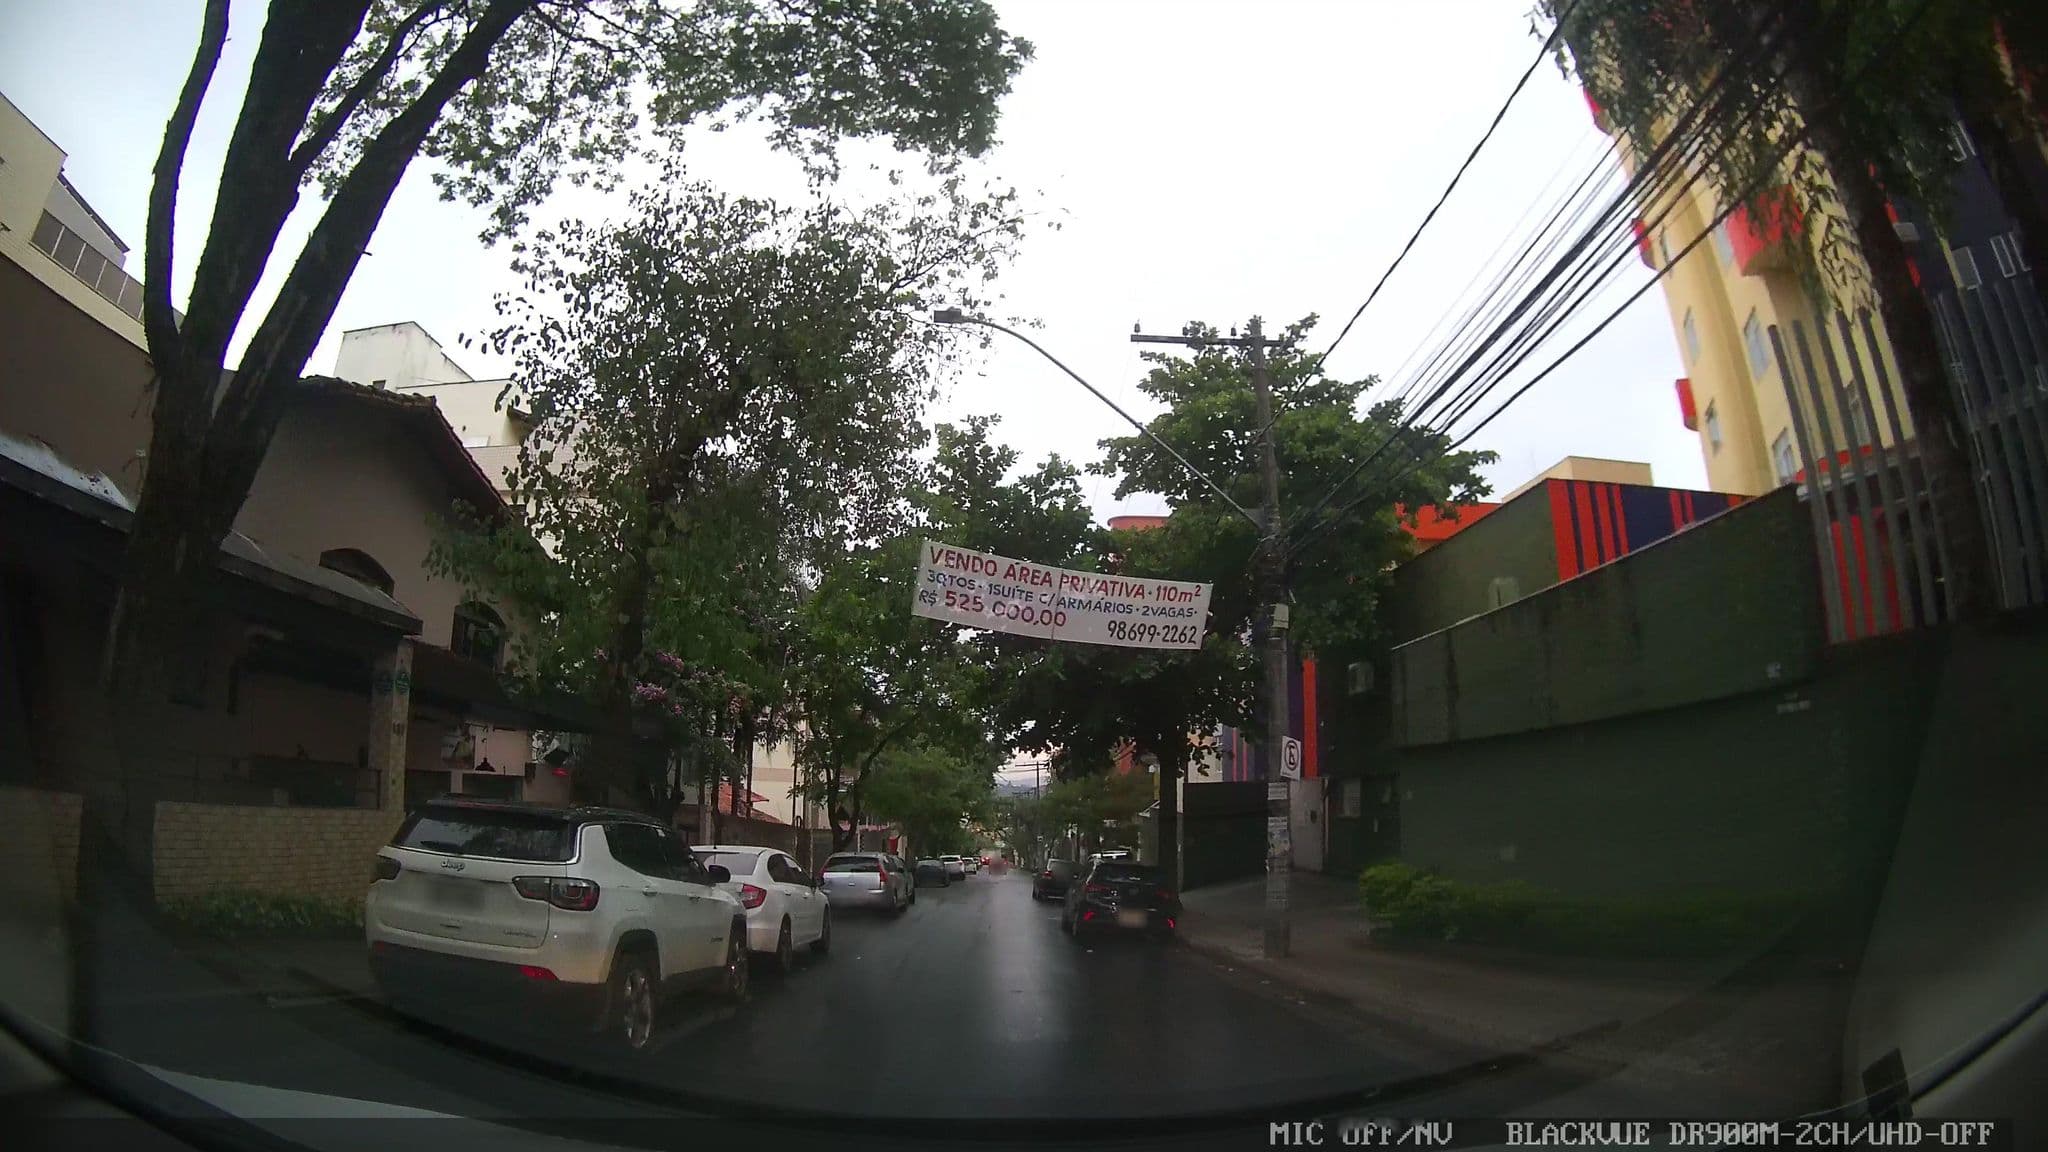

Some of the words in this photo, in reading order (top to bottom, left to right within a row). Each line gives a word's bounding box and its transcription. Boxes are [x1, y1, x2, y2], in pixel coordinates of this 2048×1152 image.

[930, 546, 998, 577] VENDO
[1003, 562, 1053, 588] ÁREA
[1059, 572, 1145, 600] PRIVATIVA
[919, 589, 938, 607] R$
